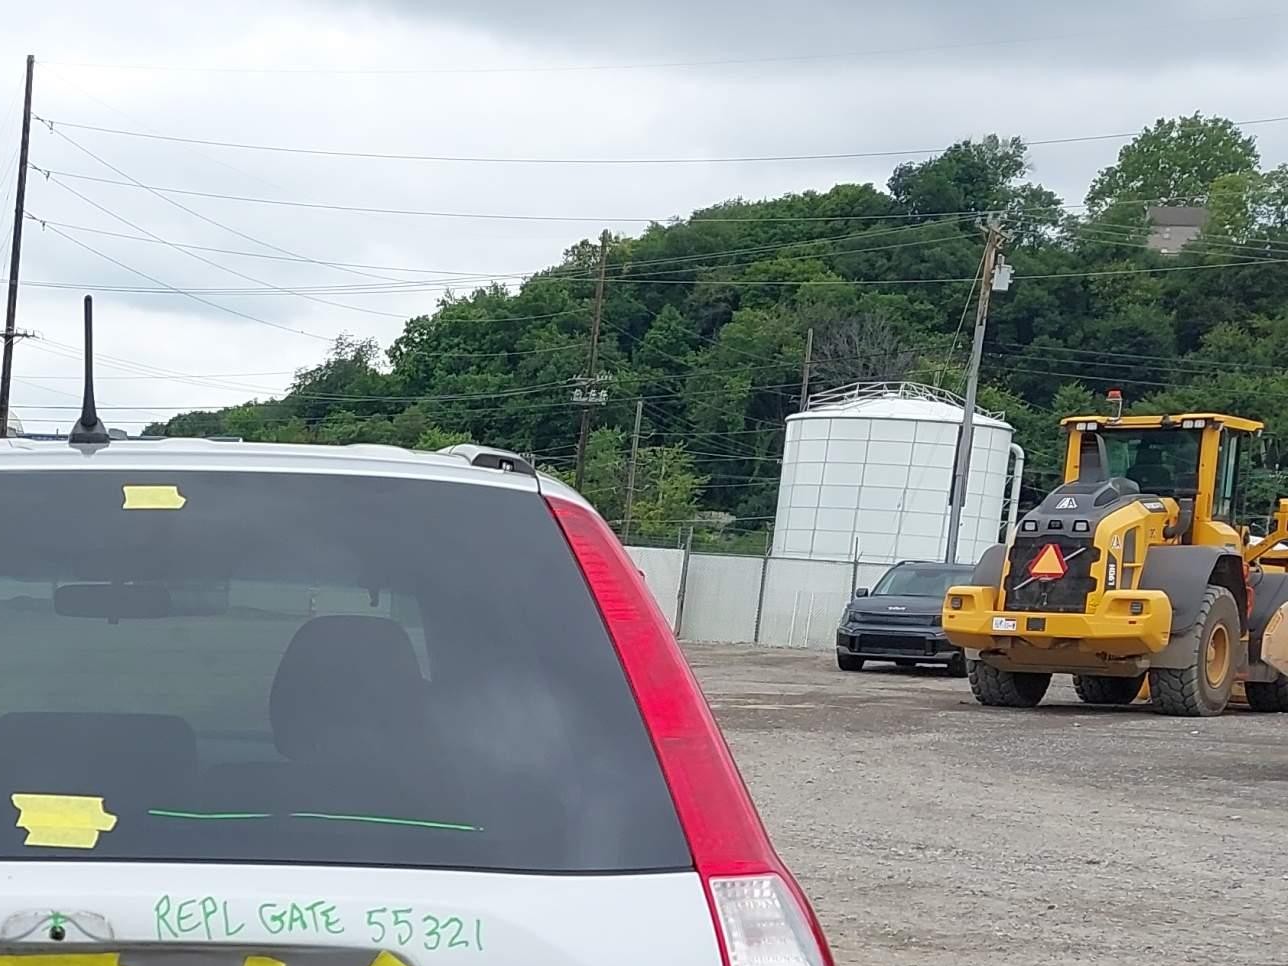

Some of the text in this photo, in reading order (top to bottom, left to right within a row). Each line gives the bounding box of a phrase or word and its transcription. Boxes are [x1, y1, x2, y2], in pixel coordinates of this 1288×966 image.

[154, 894, 484, 951] REPL GATE 55321
